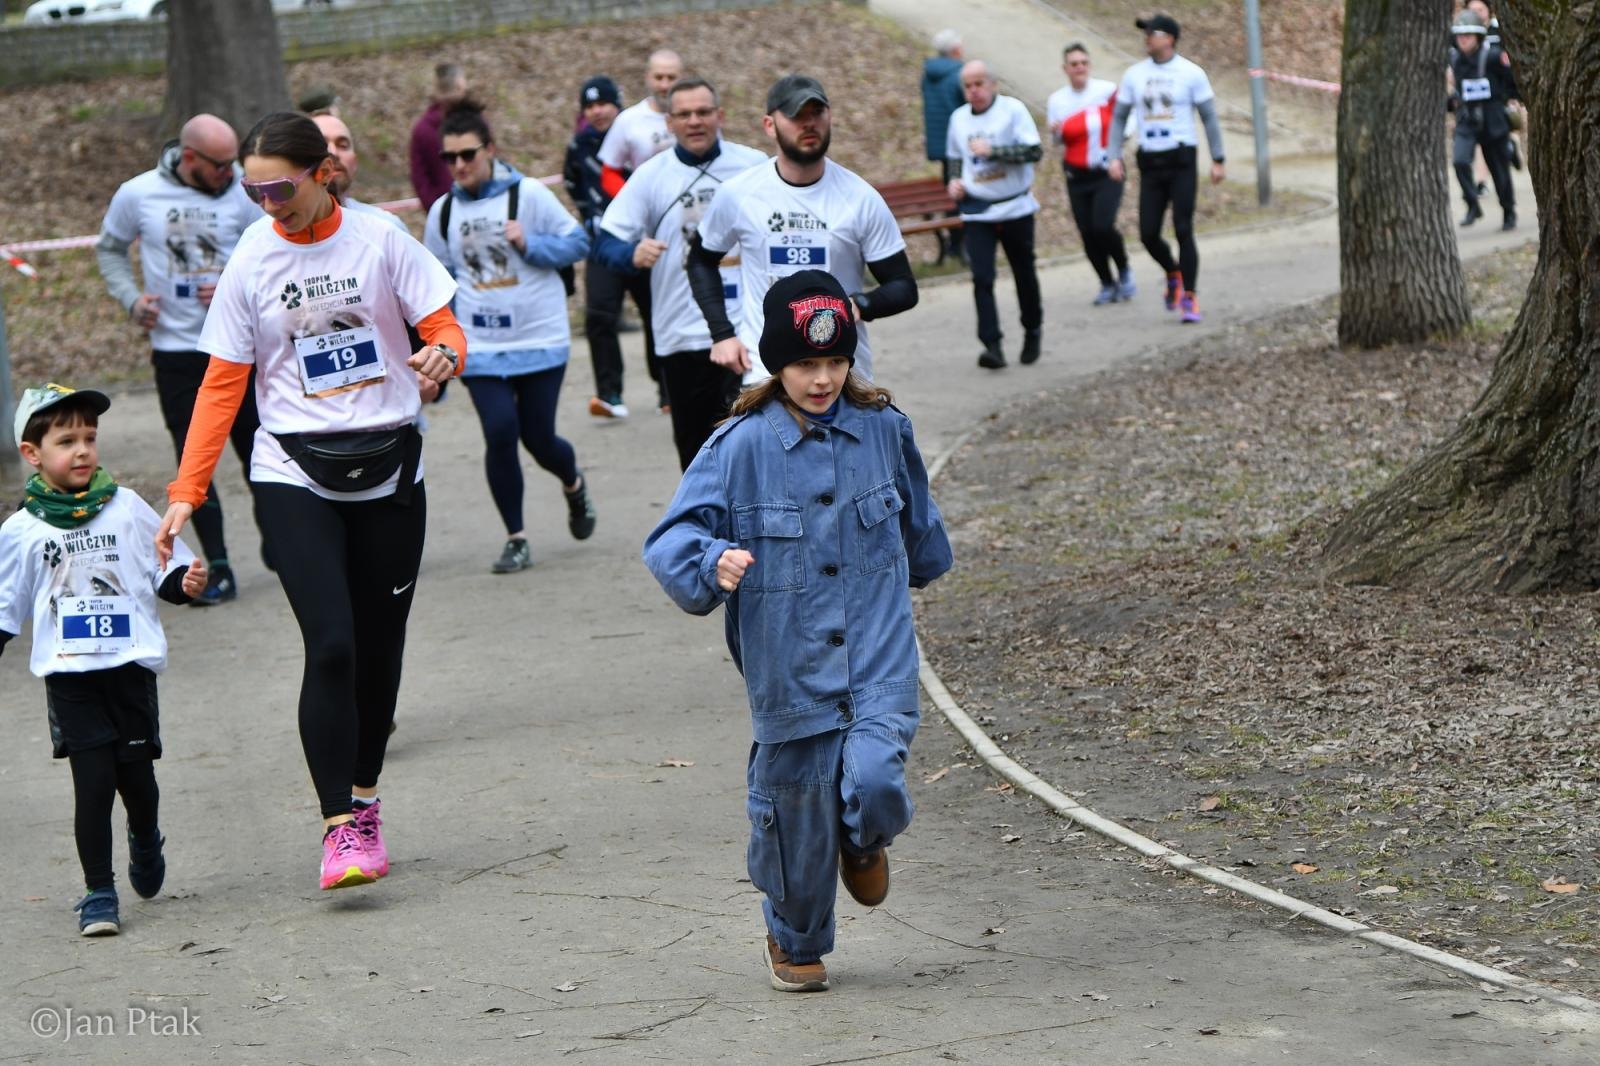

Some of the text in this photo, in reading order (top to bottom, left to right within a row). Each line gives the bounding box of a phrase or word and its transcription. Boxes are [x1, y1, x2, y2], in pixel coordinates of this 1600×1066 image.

[788, 219, 827, 230] WILCZYM
[787, 247, 811, 264] 98
[304, 274, 331, 286] TROPEM
[305, 277, 358, 299] WILCZYM
[345, 295, 362, 305] 2026
[329, 335, 356, 346] WILCZYM
[328, 347, 357, 371] 19
[346, 468, 363, 479] 4F
[62, 529, 90, 541] TROPEM
[65, 535, 117, 554] WILCZYM
[85, 615, 113, 637] 18
